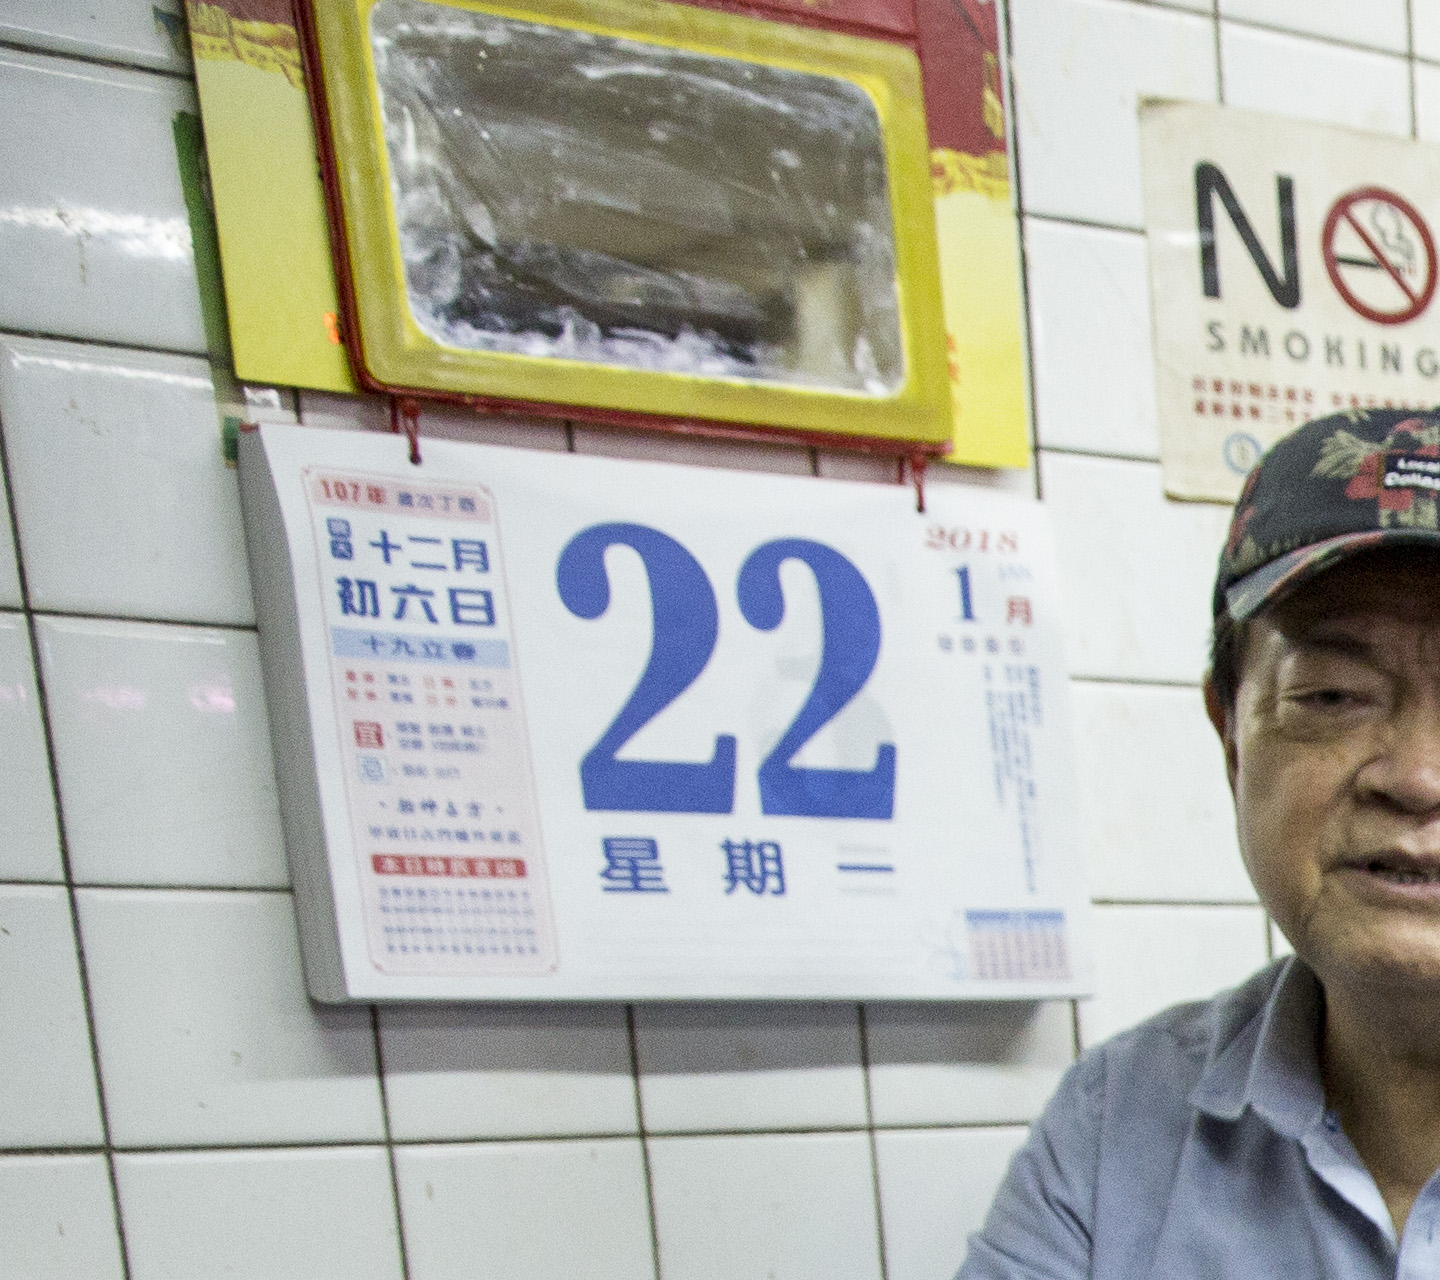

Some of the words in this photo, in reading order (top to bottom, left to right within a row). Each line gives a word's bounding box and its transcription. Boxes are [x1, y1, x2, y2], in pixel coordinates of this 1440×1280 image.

[369, 529, 490, 574] 十二月
[925, 523, 1018, 552] 2018
[335, 576, 497, 626] 初六日
[953, 565, 979, 622] 1
[1007, 596, 1033, 627] 月
[556, 521, 897, 820] 22
[599, 836, 895, 896] 星期一
